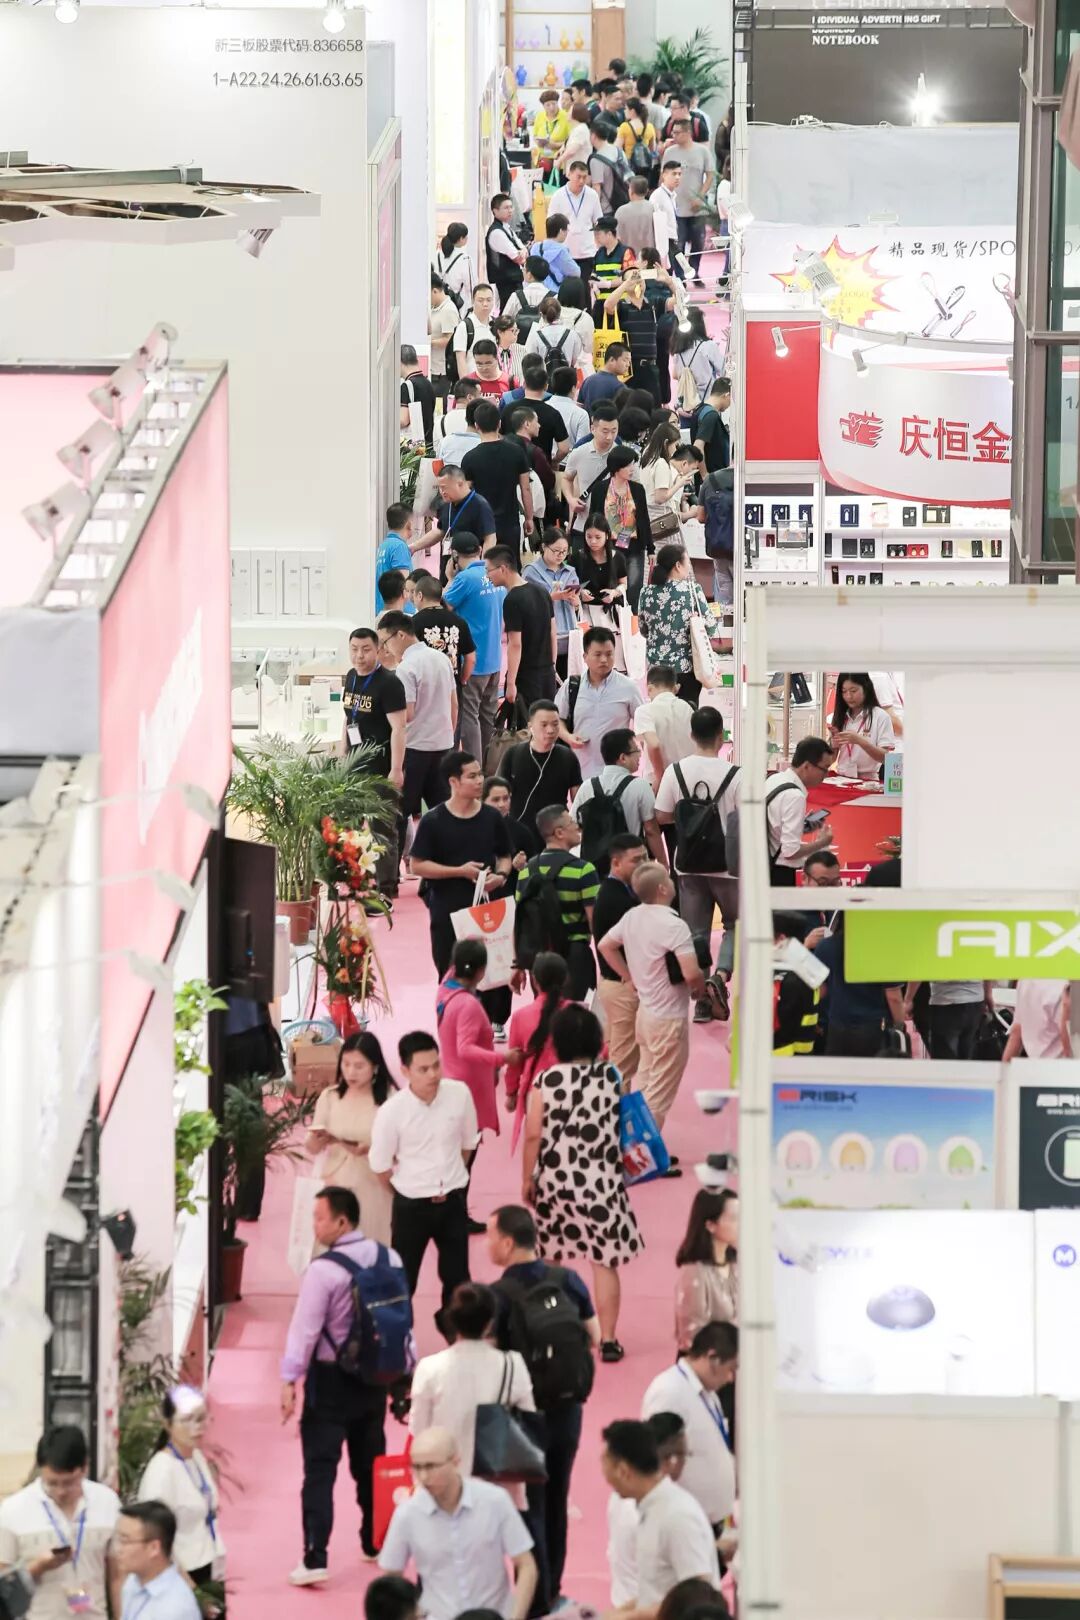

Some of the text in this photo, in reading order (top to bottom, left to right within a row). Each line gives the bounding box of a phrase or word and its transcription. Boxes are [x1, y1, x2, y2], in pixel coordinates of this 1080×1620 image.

[920, 14, 941, 23] GIFT
[812, 34, 880, 45] NOTEBOOK
[937, 920, 1080, 958] AIX
